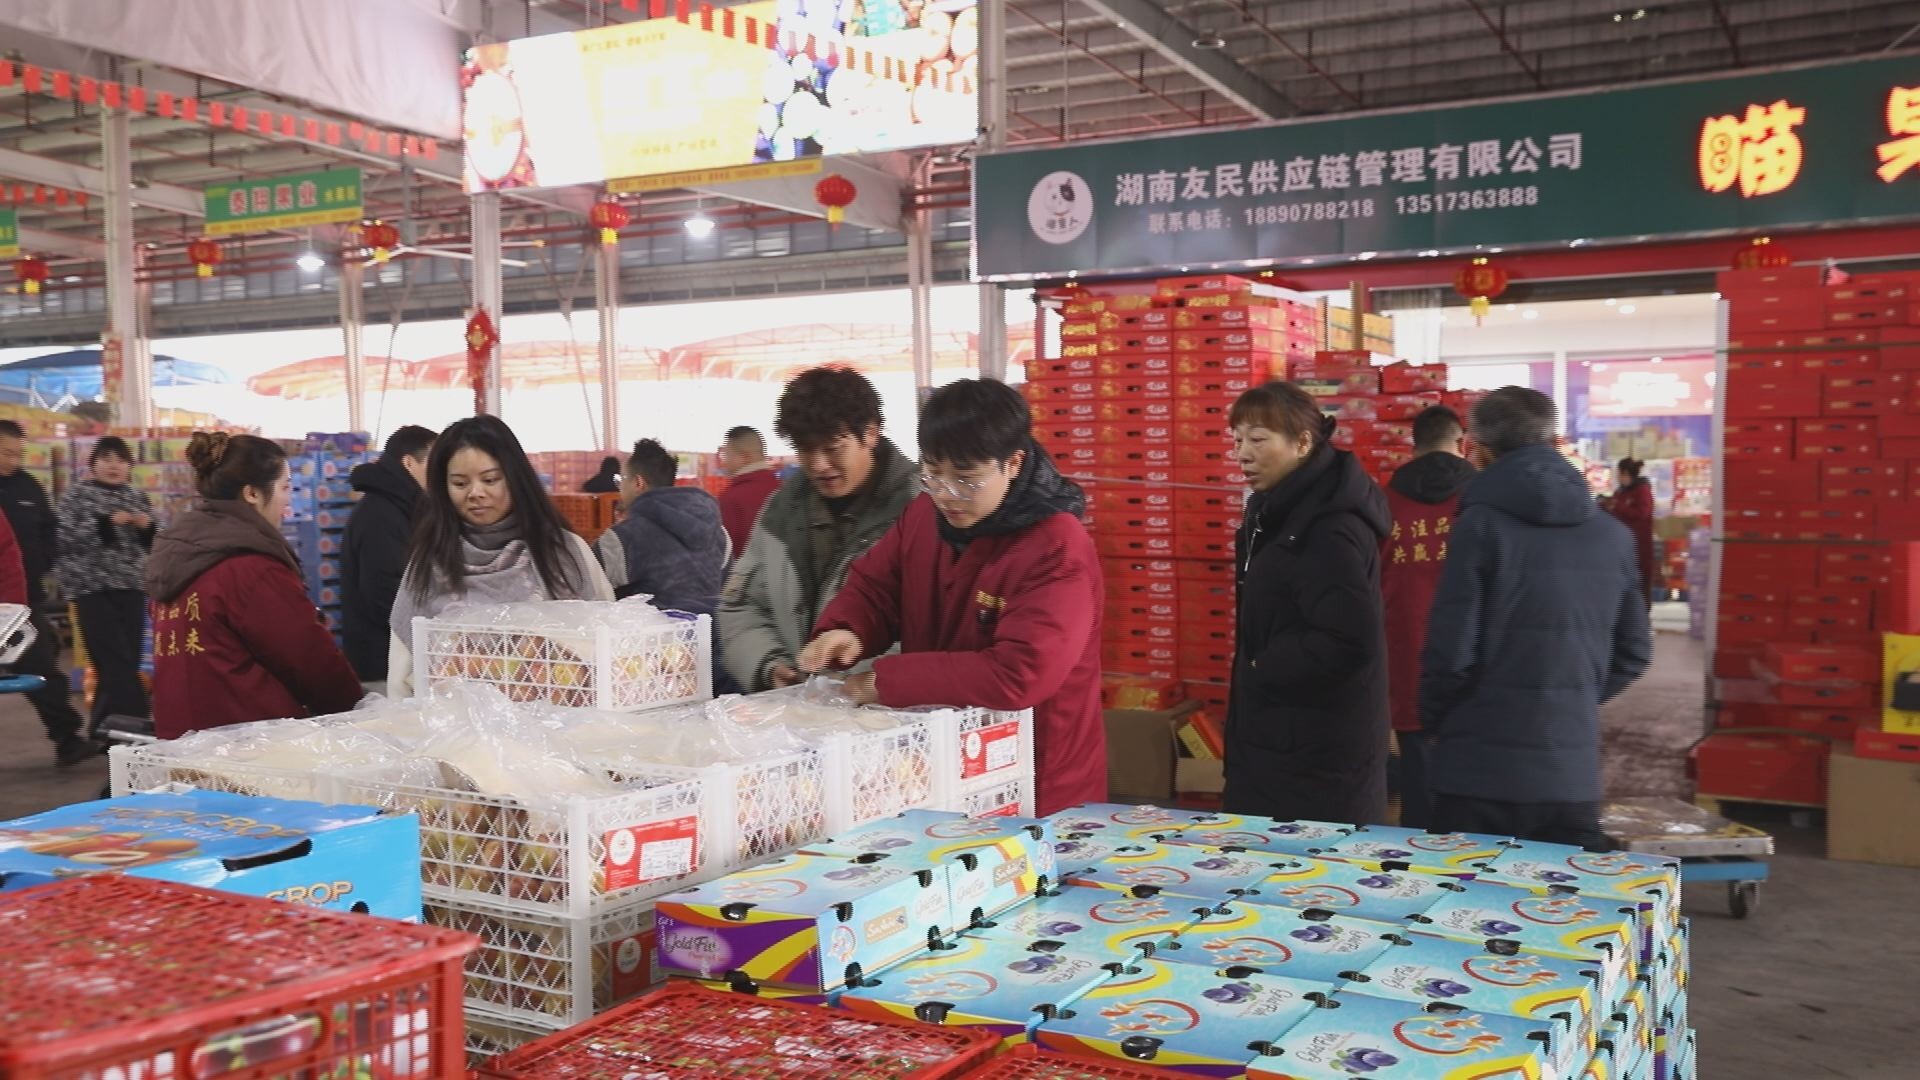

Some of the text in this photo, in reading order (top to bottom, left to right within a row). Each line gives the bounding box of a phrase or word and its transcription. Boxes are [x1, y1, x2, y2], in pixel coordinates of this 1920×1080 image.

[1113, 132, 1583, 206] 湖南友民供应链管理有限公司
[1245, 199, 1374, 226] 18890788218
[1396, 186, 1538, 214] 13517363888
